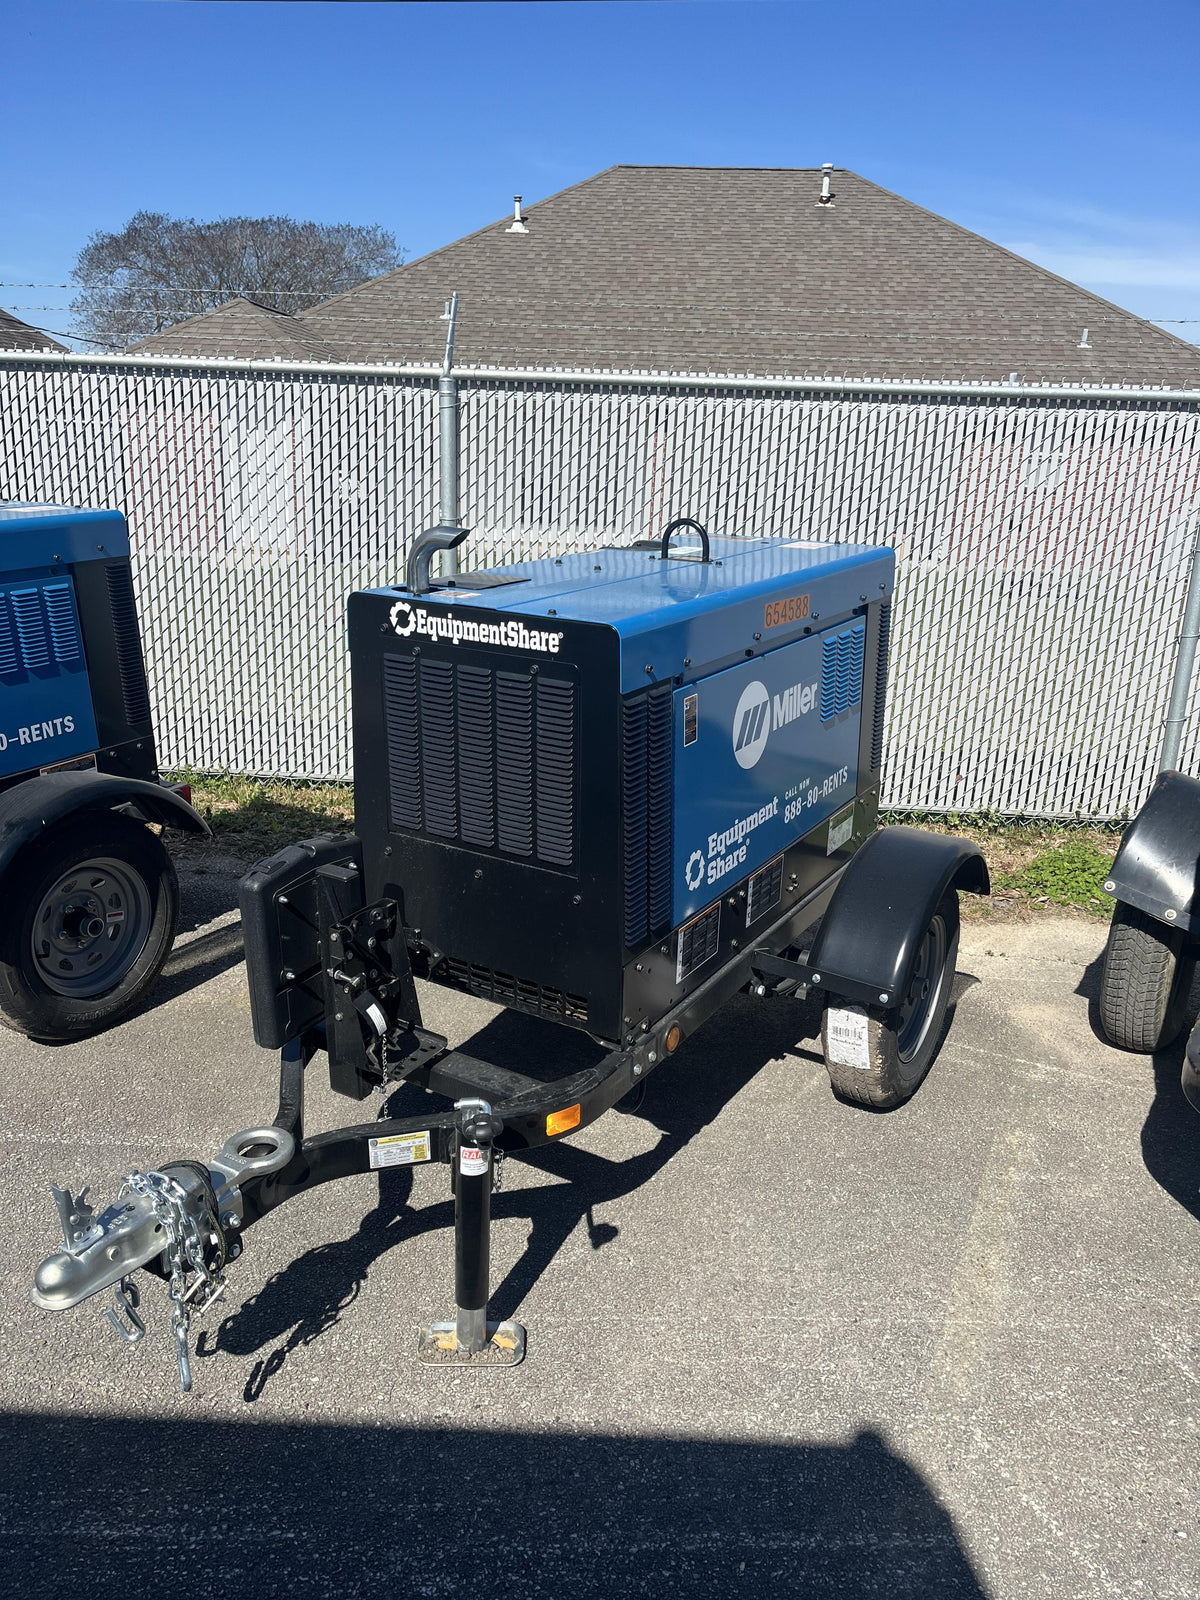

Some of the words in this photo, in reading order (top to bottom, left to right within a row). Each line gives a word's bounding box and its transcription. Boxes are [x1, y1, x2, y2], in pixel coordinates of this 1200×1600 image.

[765, 595, 810, 628] 654588
[773, 682, 818, 731] Miller
[784, 785, 799, 801] CALL
[799, 777, 811, 792] NOW
[784, 765, 848, 824] 888-80-RENTS
[707, 795, 779, 859] Equipment
